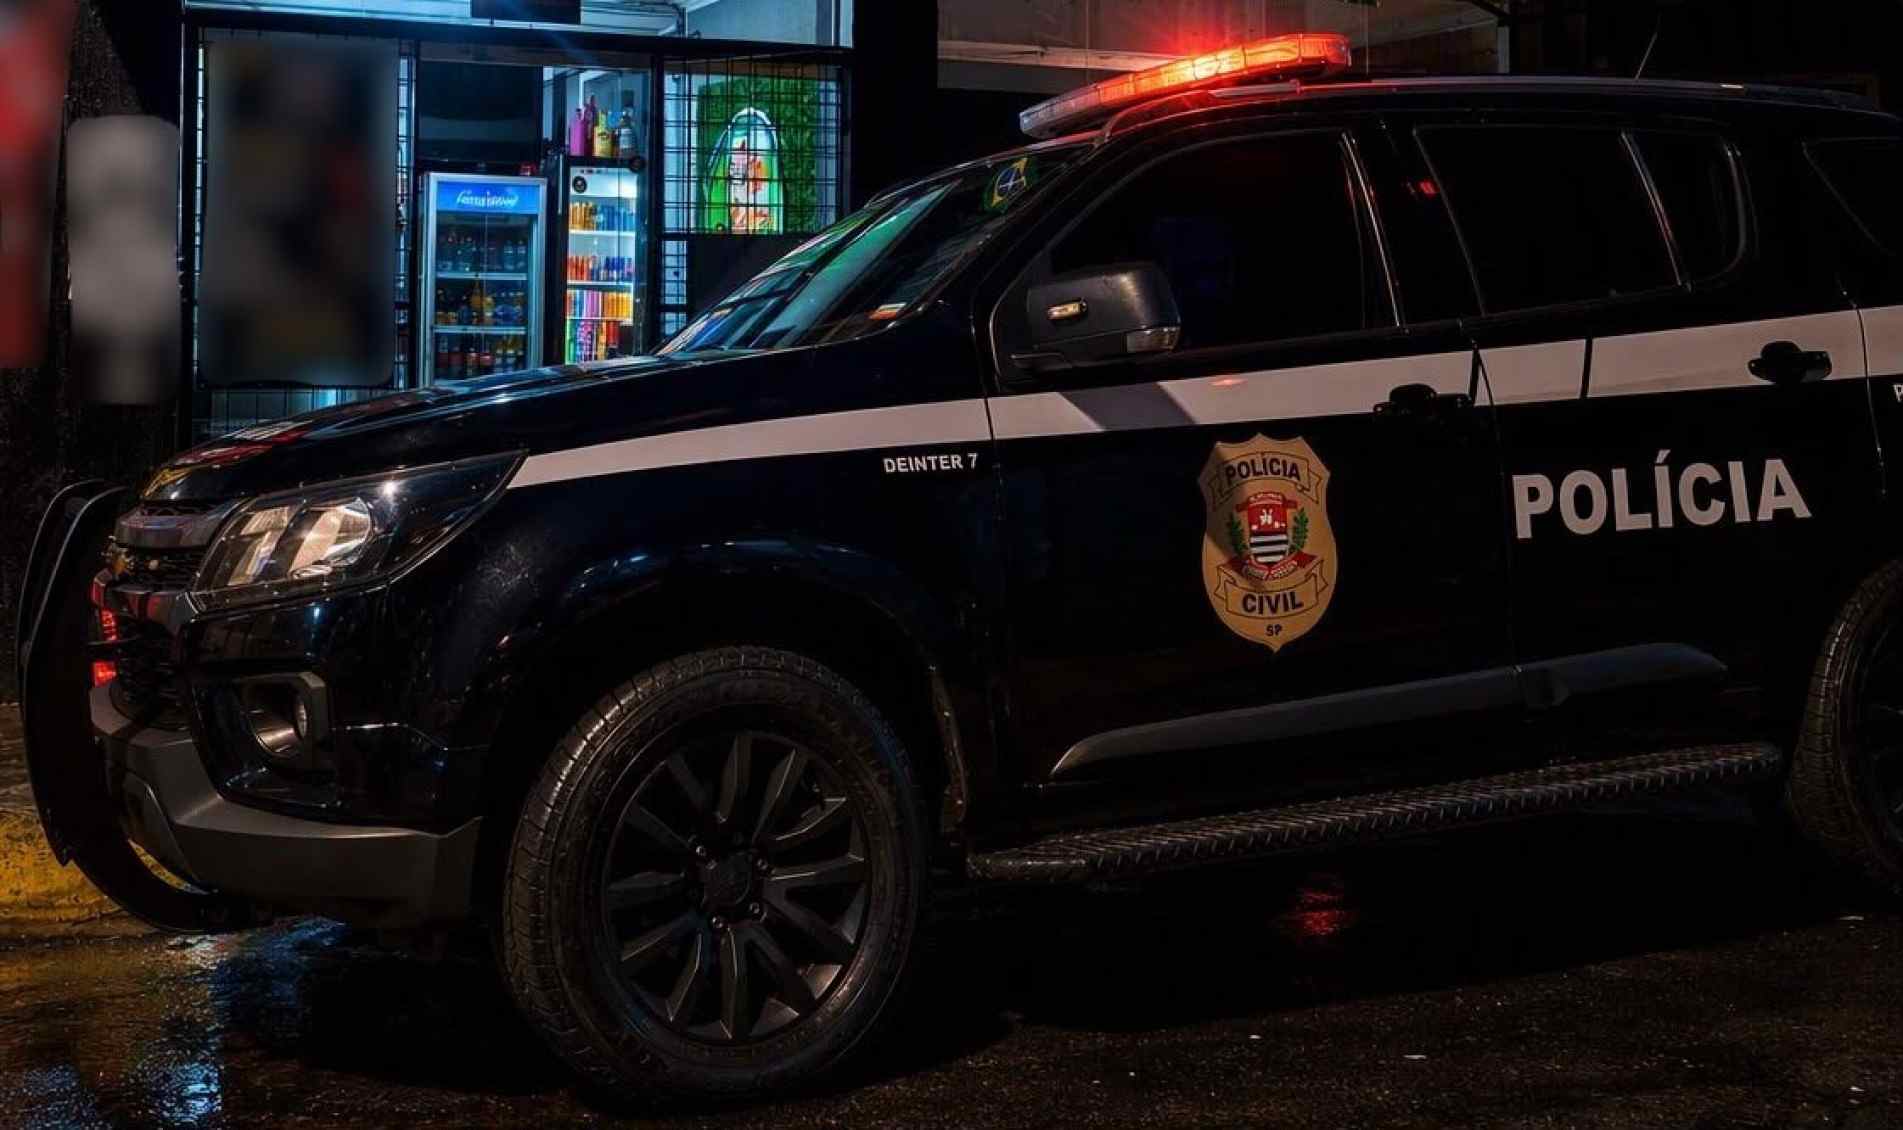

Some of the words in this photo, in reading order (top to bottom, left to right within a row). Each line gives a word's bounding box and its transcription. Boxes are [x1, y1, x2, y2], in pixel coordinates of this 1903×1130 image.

[883, 453, 964, 473] DEINTER
[967, 452, 978, 469] 7
[1512, 449, 1812, 539] POLÍCIA
[1242, 591, 1304, 615] CIVIL
[1265, 624, 1283, 637] SP
